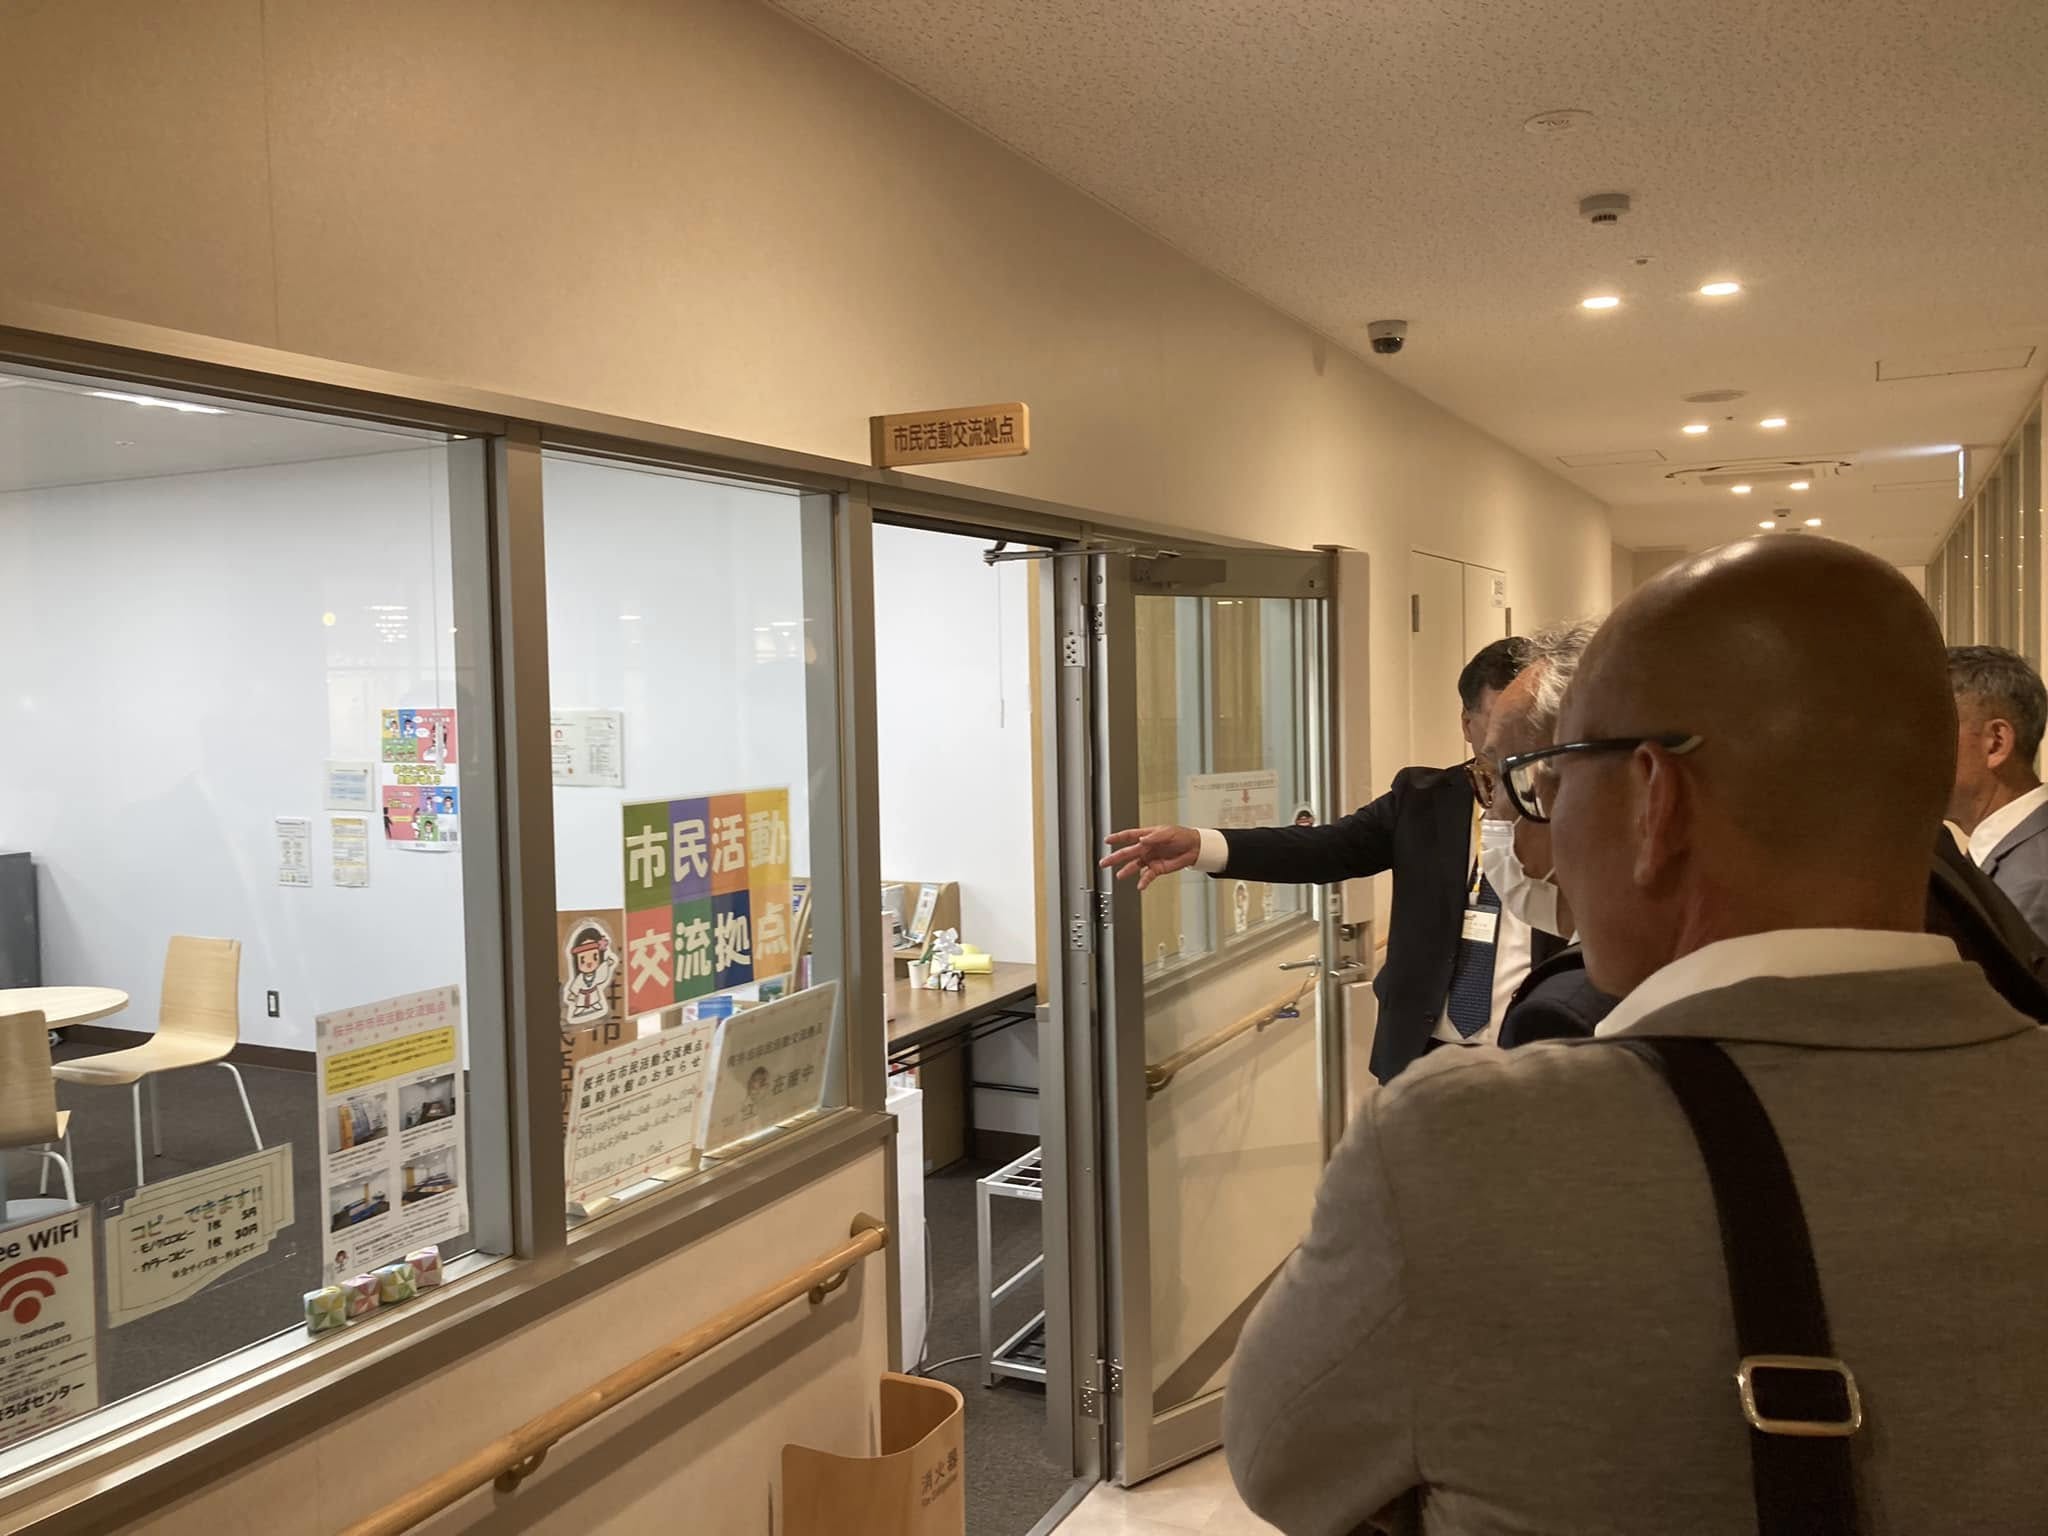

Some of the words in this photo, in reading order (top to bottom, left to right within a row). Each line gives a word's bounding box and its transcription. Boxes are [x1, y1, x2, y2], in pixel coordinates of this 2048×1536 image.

[893, 415, 1015, 452] 市民活動交流拠点
[625, 809, 788, 889] 市民活動
[628, 901, 791, 994] 交流拠点
[580, 1057, 702, 1109] 臨時休館のお知らせ
[582, 1039, 703, 1092] 桜井市市民活動交流拠点
[28, 1219, 79, 1252] WiFi
